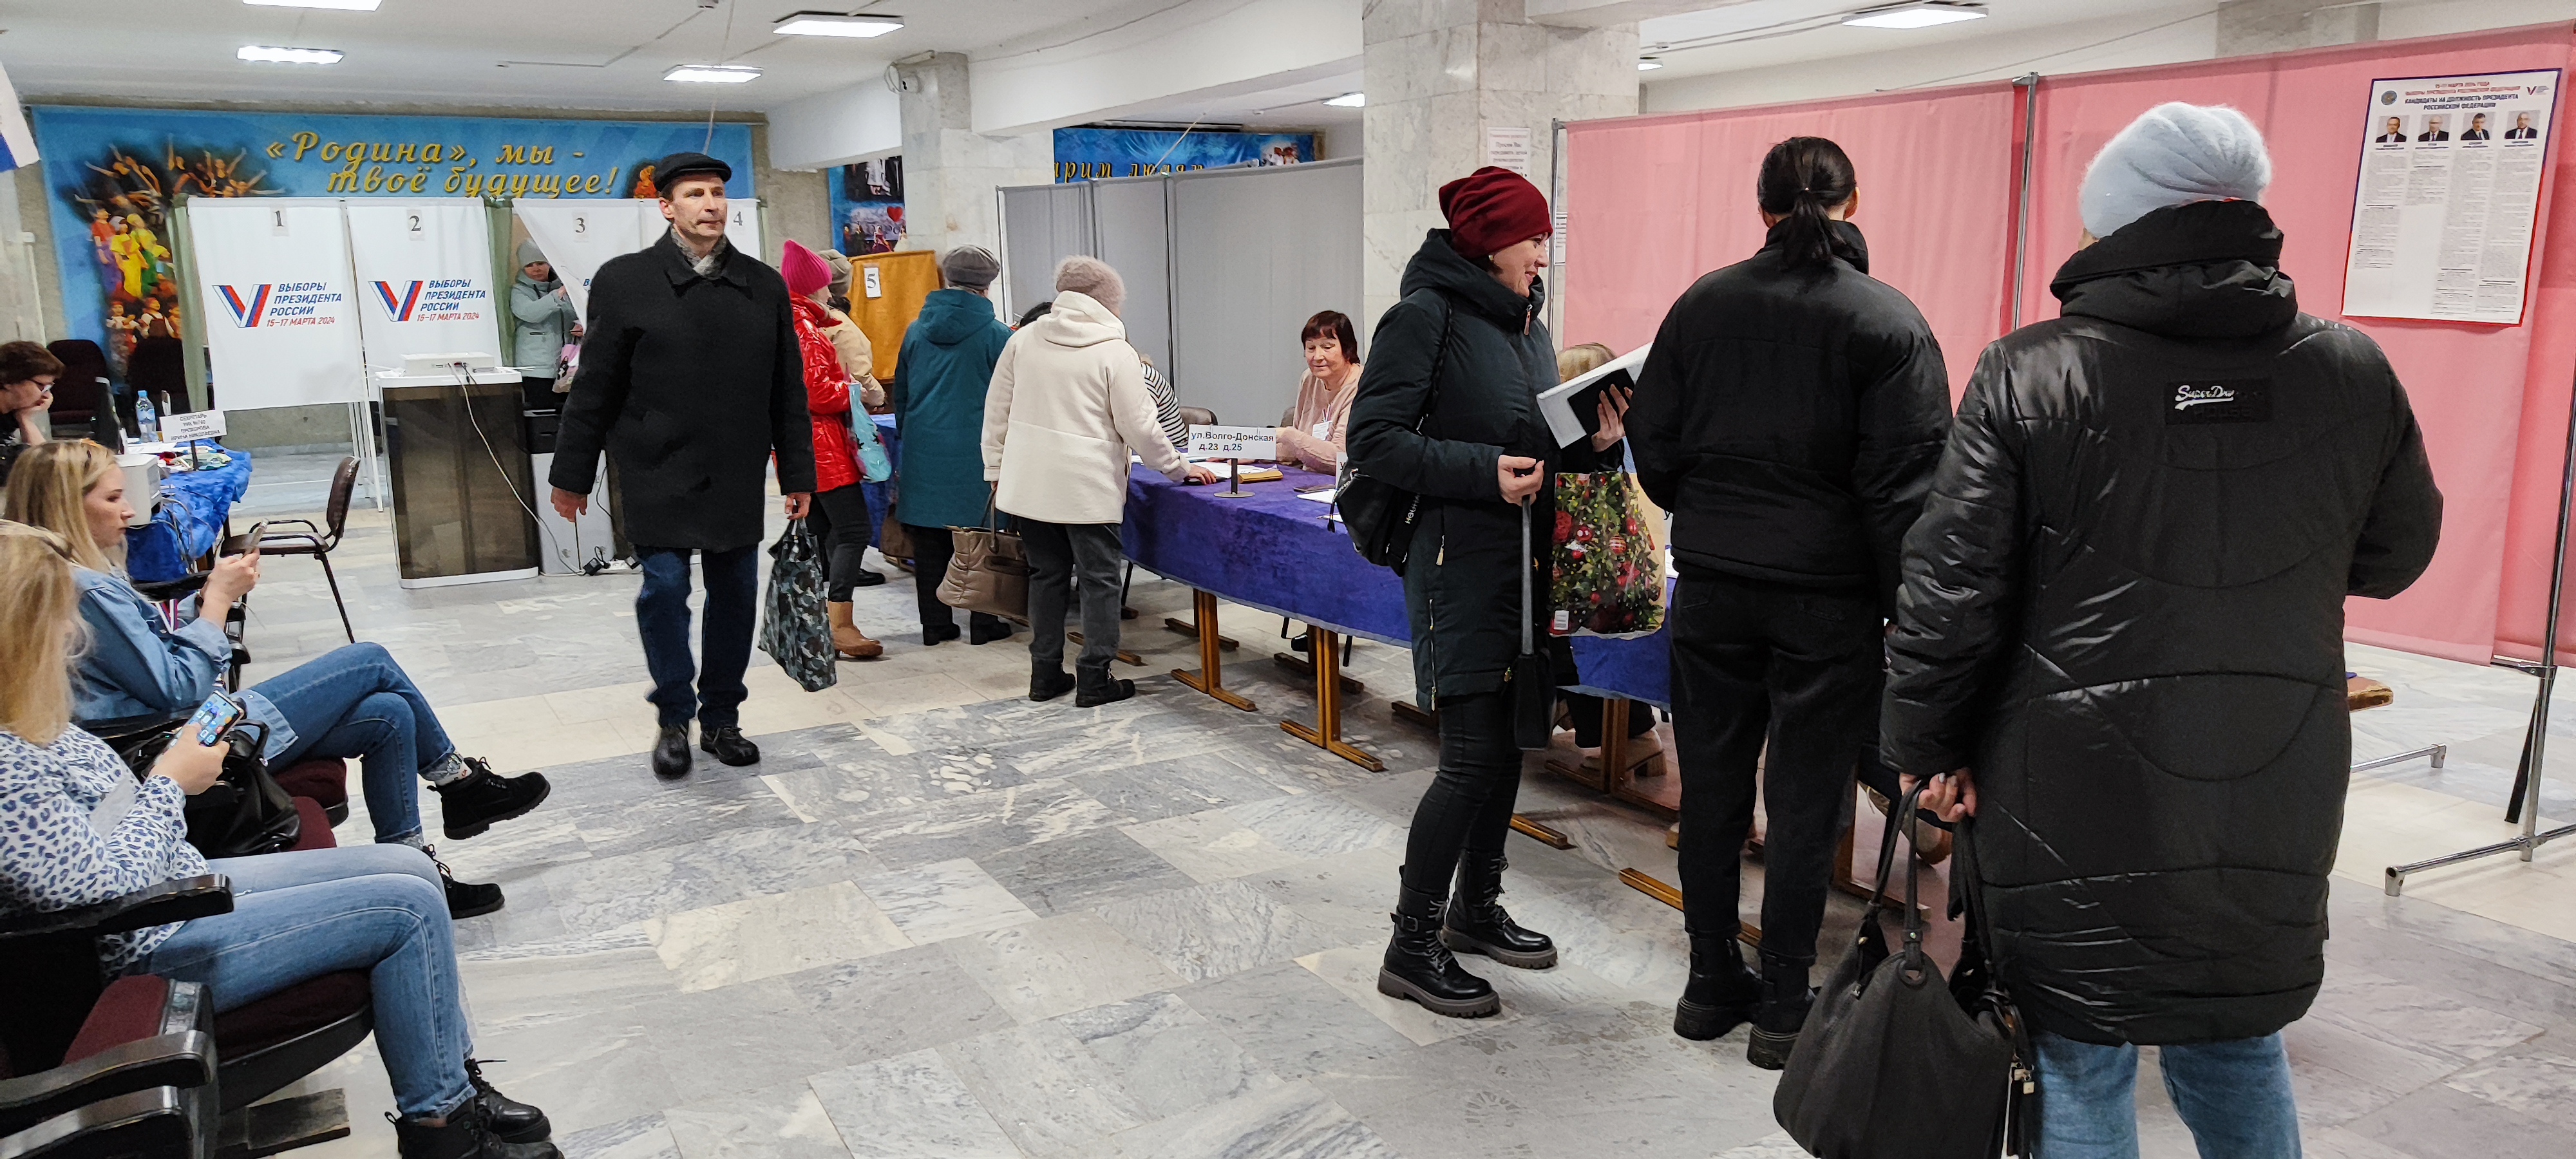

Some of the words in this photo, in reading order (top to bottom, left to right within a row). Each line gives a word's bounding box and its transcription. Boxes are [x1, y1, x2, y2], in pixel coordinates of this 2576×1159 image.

[496, 144, 554, 164] мы
[327, 165, 428, 193] твоё
[444, 166, 618, 198] будущее!
[274, 210, 284, 227] 1
[409, 215, 422, 232] 2
[733, 211, 743, 226] 4
[574, 217, 585, 233] 3
[428, 279, 471, 288] ВЫБОРЫ
[867, 273, 876, 289] 5
[278, 282, 327, 292] ВЫБОРЫ
[274, 293, 342, 305] ПРЕЗИДЕНТА
[424, 290, 486, 301] ПРЕЗИДЕНТА
[269, 306, 315, 316] РОССИИ
[420, 302, 460, 312] РОССИИ
[289, 317, 316, 326] МАРТА
[317, 316, 336, 325] 2024
[437, 312, 461, 321] МАРТА
[1191, 431, 1274, 442] ул.Волго-Донская
[1198, 442, 1219, 451] д.23
[1222, 443, 1242, 451] д.25
